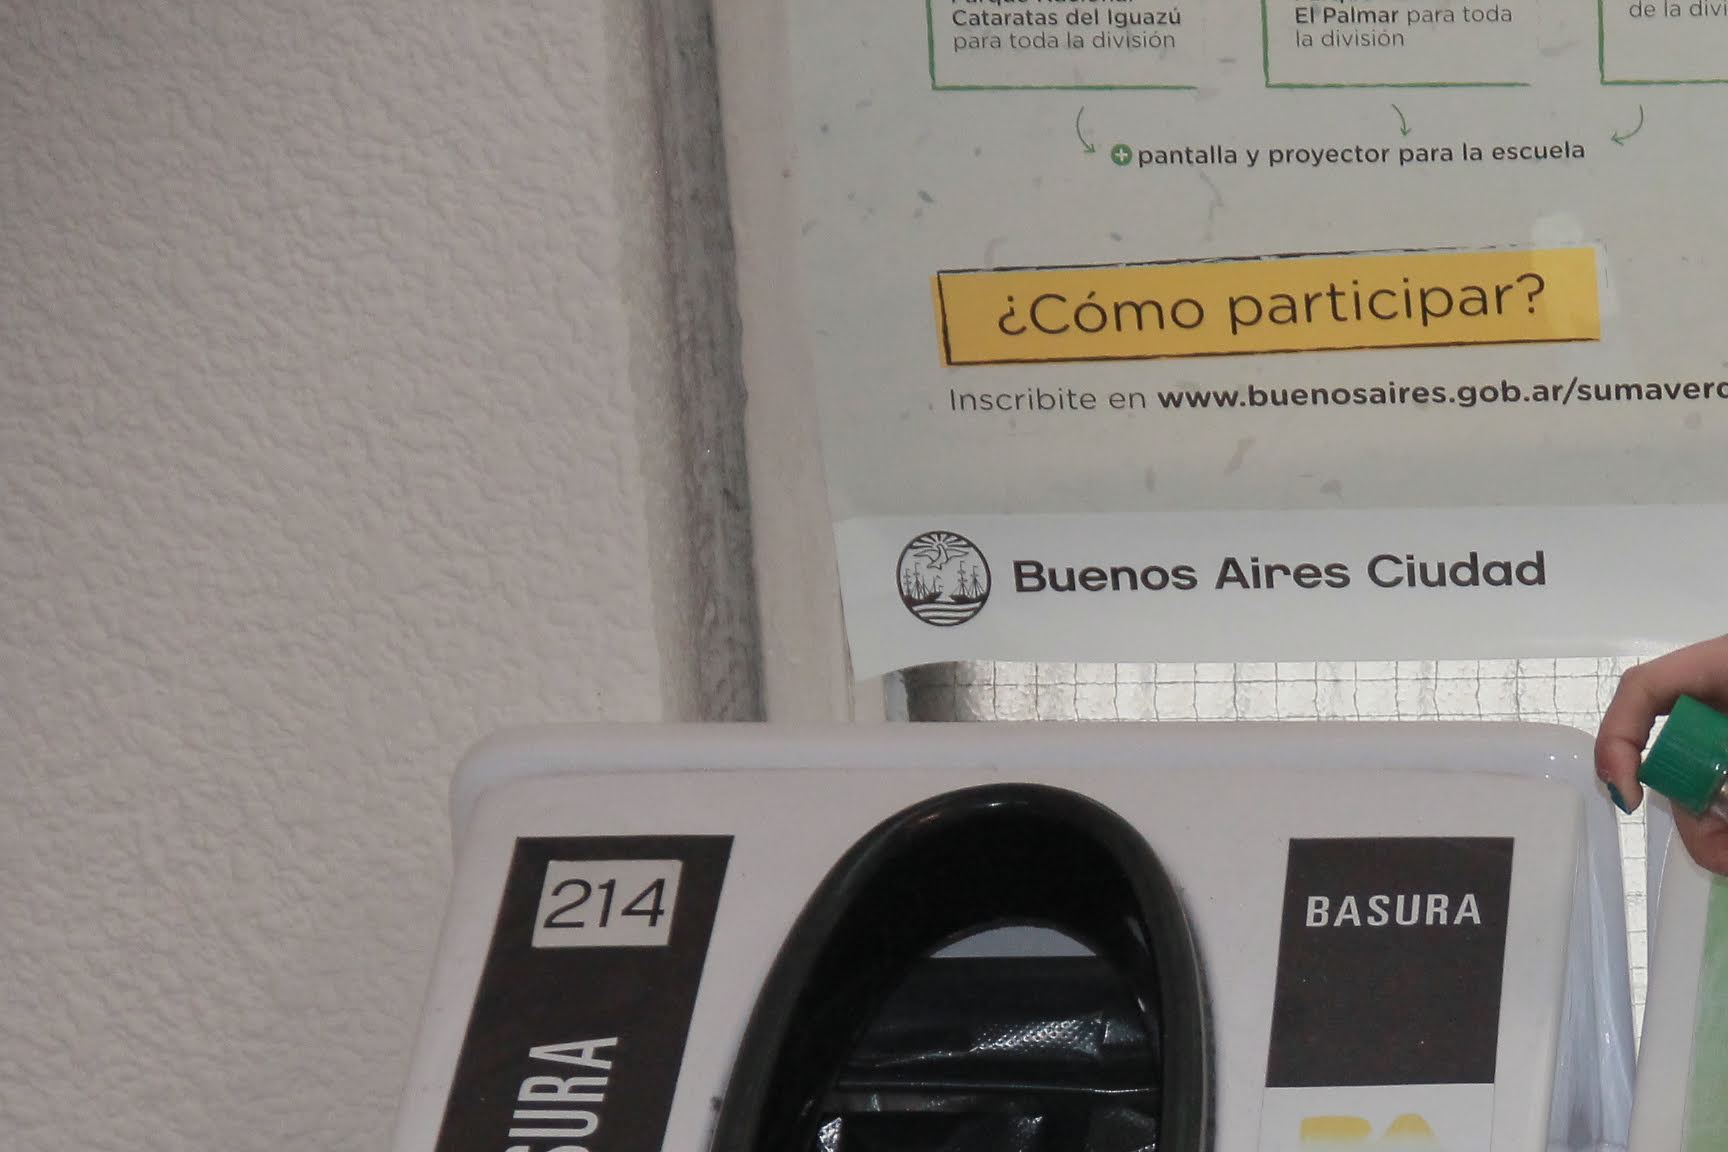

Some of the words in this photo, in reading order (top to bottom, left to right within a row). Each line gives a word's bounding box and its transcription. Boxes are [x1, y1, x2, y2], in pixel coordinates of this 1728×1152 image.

[952, 9, 1058, 27] Cataratas
[1066, 8, 1099, 26] del
[1108, 7, 1181, 27] Iguazú
[1295, 8, 1314, 24] El
[1323, 6, 1399, 23] Palmar
[1407, 6, 1455, 25] para
[1463, 4, 1512, 22] toda
[1629, 0, 1655, 17] de
[1664, 0, 1681, 17] la
[953, 34, 1001, 52] para
[1009, 32, 1058, 49] toda
[1067, 31, 1084, 49] la
[1092, 31, 1175, 49] división
[1296, 29, 1314, 47] la
[1321, 28, 1404, 46] división
[1138, 144, 1238, 168] pantalla
[1246, 150, 1258, 167] y
[1268, 146, 1389, 167] proyector
[1399, 147, 1453, 165] para
[1463, 142, 1484, 161] la
[1492, 141, 1586, 161] escuela
[999, 290, 1204, 336] ¿Cómo
[1229, 272, 1546, 334] participar?
[950, 388, 1097, 411] Inscribite
[1109, 391, 1146, 409] en
[1013, 559, 1198, 593] Buenos
[1215, 556, 1350, 590] Aires
[1367, 550, 1547, 588] Ciudad
[544, 878, 665, 929] 214
[1305, 893, 1482, 928] BASURA
